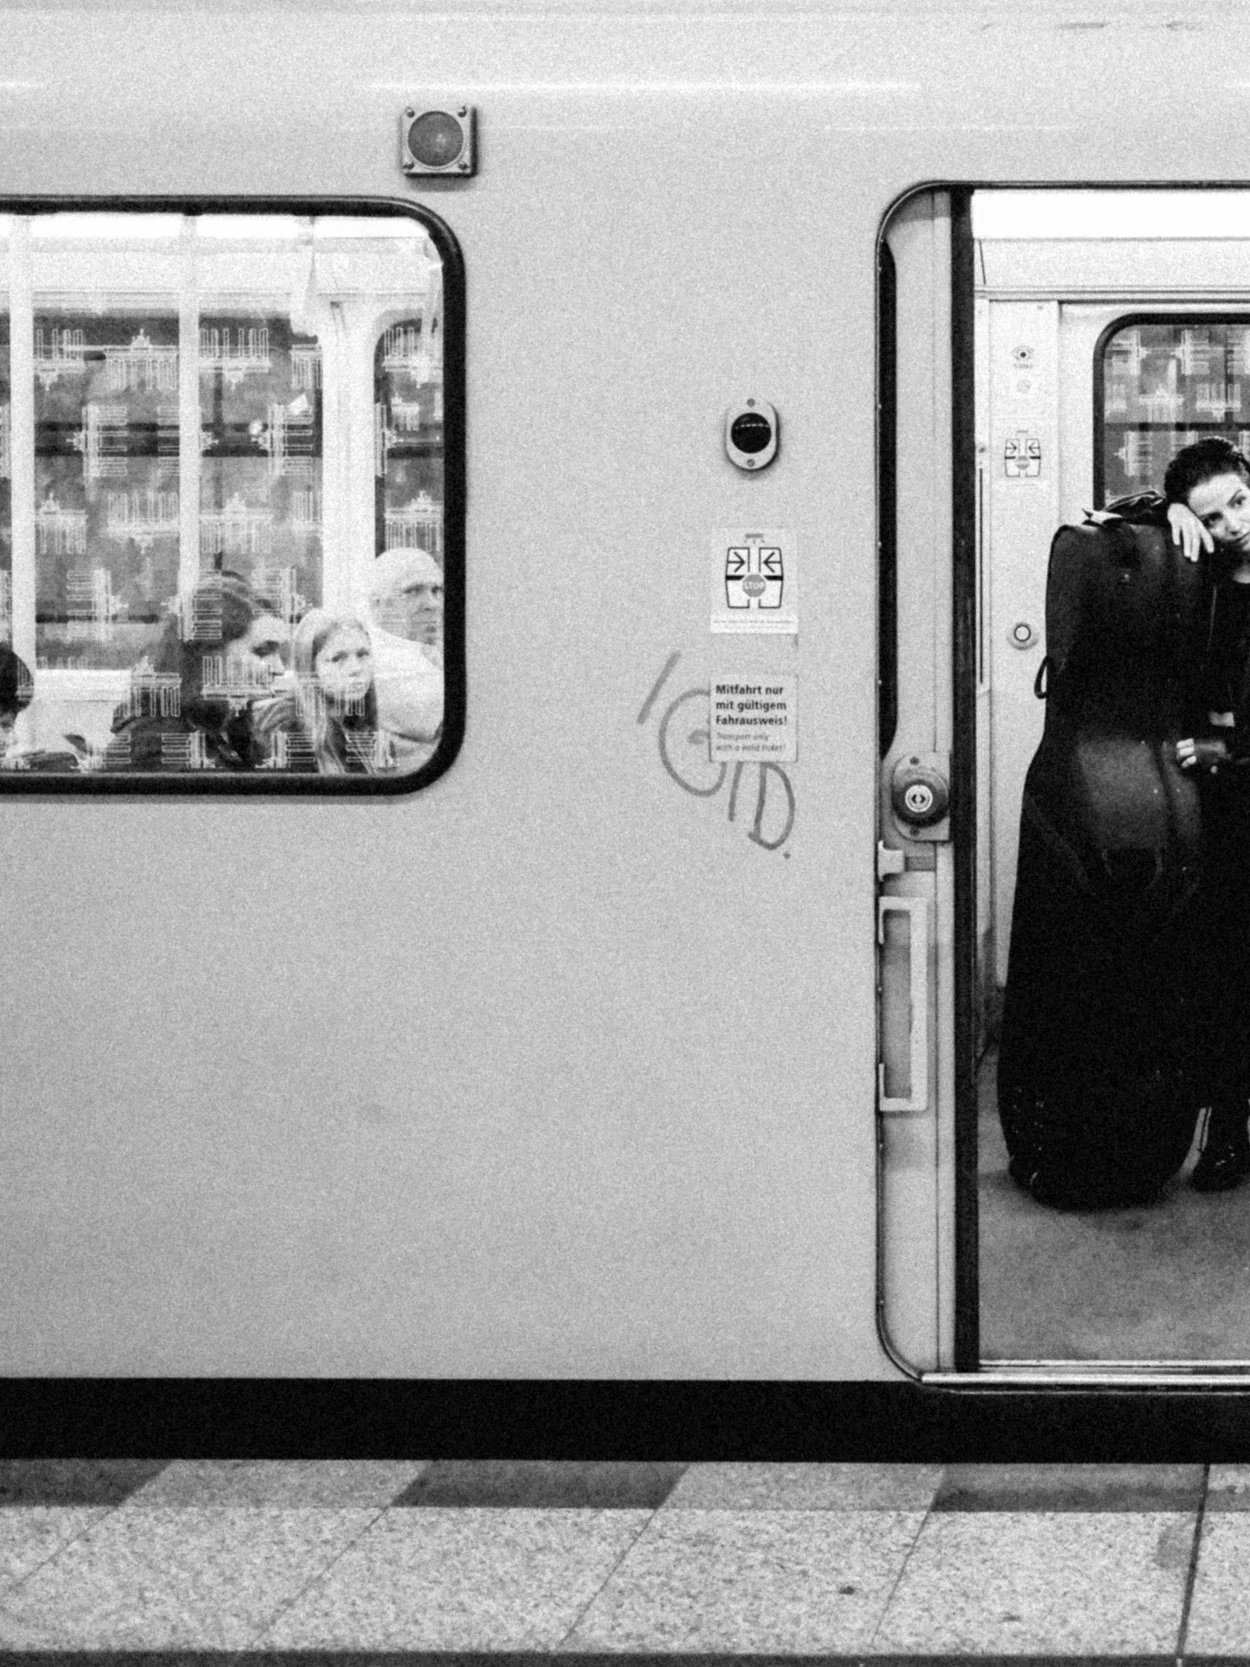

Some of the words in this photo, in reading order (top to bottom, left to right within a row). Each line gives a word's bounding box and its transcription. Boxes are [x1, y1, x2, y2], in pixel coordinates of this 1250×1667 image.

[743, 581, 766, 590] STOP
[716, 684, 762, 695] Mitfahrt
[765, 687, 784, 695] nur
[716, 700, 734, 710] mit
[737, 700, 787, 713] gültigem
[715, 714, 788, 726] Fahrausweis!
